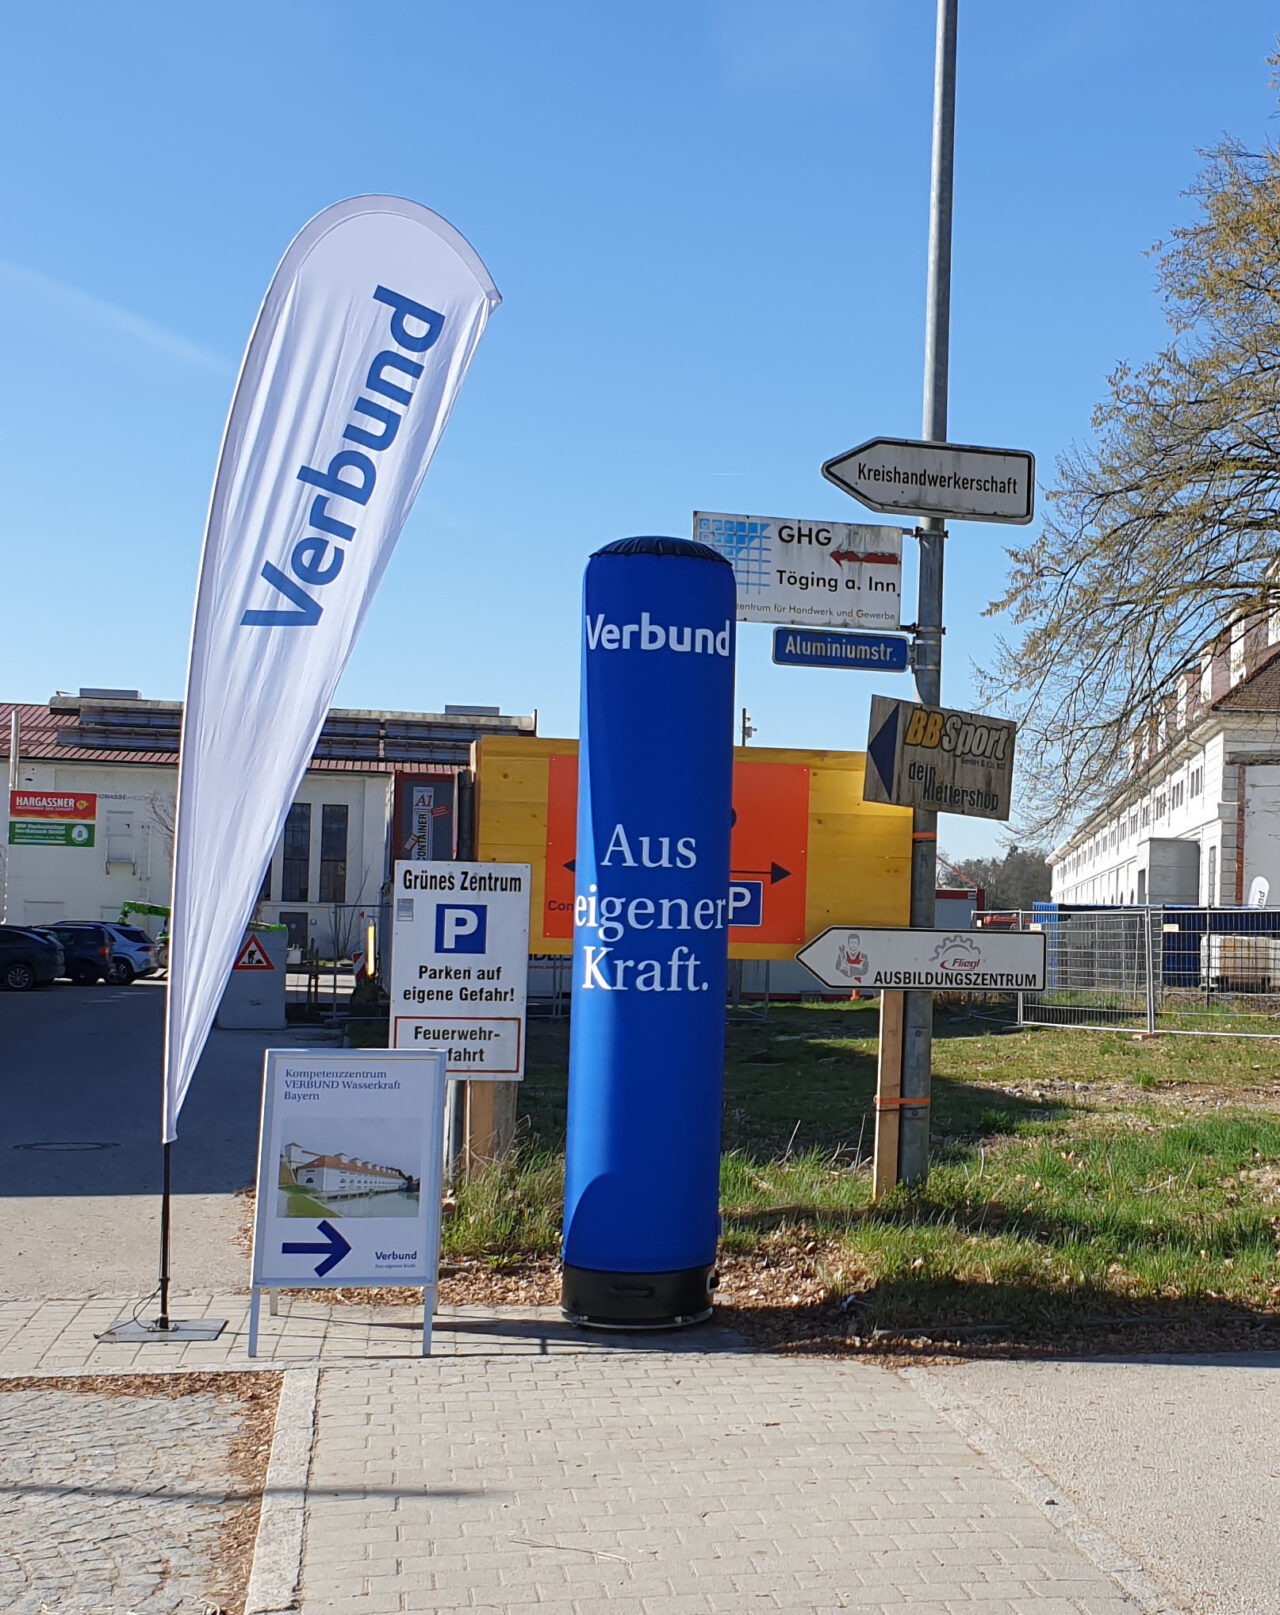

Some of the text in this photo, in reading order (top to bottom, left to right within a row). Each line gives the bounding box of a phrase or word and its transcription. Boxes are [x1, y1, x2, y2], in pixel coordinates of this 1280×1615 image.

[240, 285, 445, 626] Verbund
[857, 463, 1018, 494] Kreishandwerkerschaft
[778, 525, 832, 546] GHG
[776, 570, 896, 592] Töging a. Inn
[774, 604, 786, 613] für
[789, 605, 834, 616] Handwerk
[836, 607, 853, 617] und
[856, 609, 895, 620] Gewerbe
[586, 612, 730, 657] Verbund
[785, 635, 897, 661] Aluminiumstr.
[909, 761, 936, 781] dein
[16, 796, 75, 808] HARGASSNER
[601, 824, 697, 869] Aus
[403, 869, 522, 892] Grünes Zentrum
[575, 884, 726, 942] eigener
[728, 886, 751, 920] P
[443, 908, 479, 949] P
[419, 965, 502, 980] Parken auf
[582, 945, 709, 991] Kraft.
[874, 971, 1037, 987] AUSBILDUNGSZENTRUM
[403, 987, 515, 1003] eigene Gefahr!
[414, 1026, 500, 1041] Feuerwehr-
[430, 1047, 485, 1062] fahrt
[285, 1069, 387, 1080] Kompetenzzentrum
[285, 1080, 401, 1090] VERBUND Wasserkraft
[284, 1091, 320, 1102] Bayern
[375, 1251, 418, 1260] Verbund
